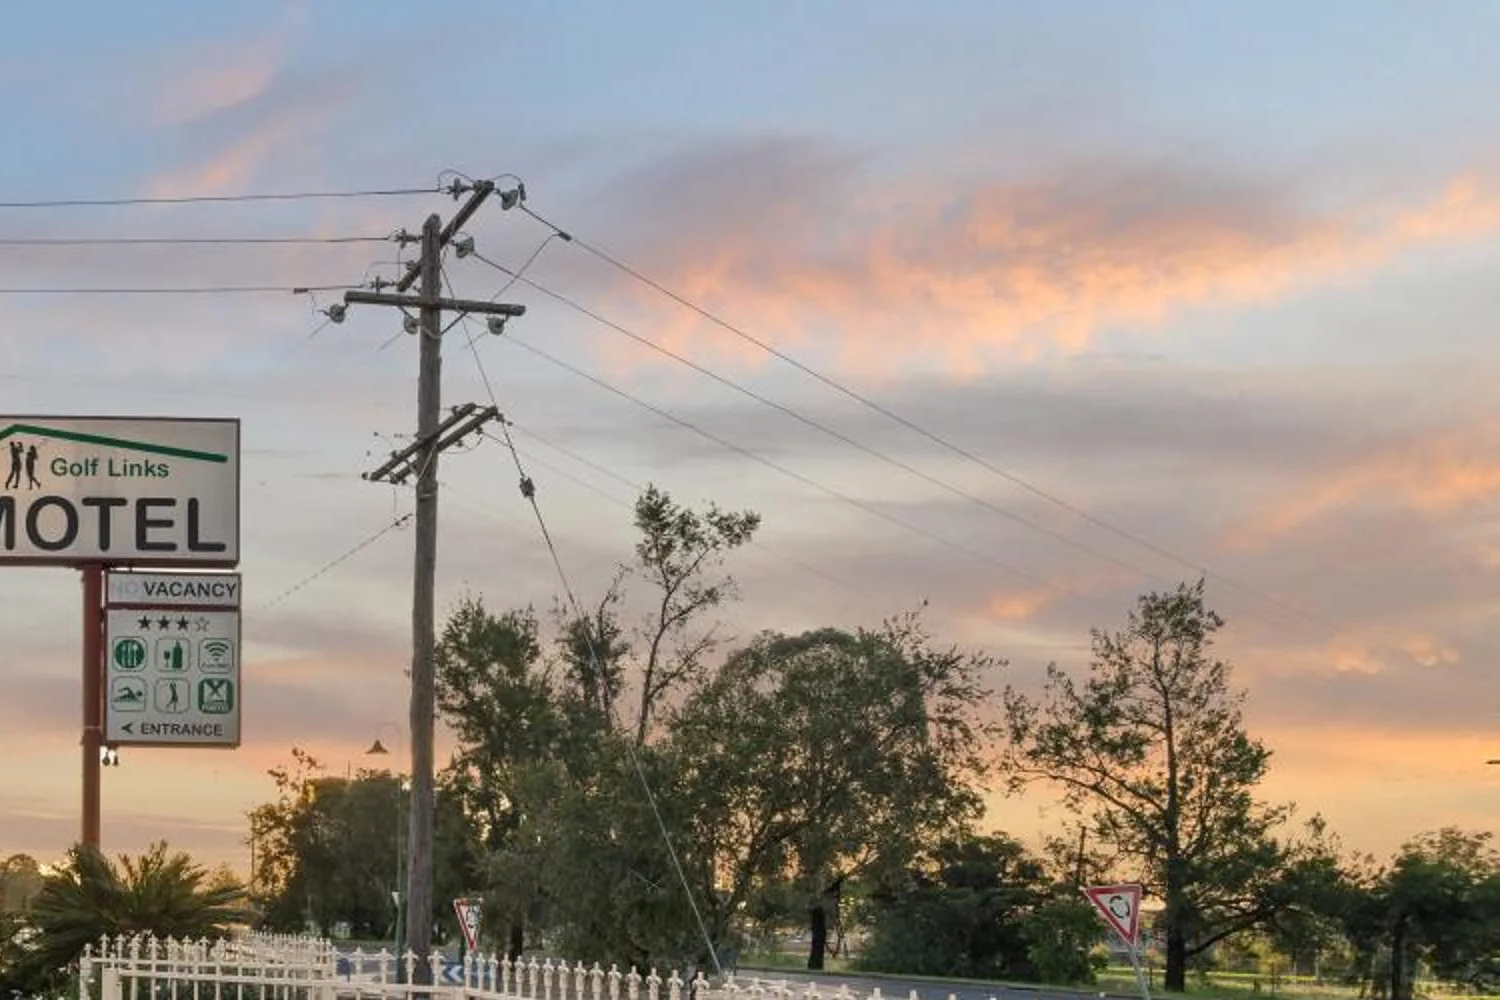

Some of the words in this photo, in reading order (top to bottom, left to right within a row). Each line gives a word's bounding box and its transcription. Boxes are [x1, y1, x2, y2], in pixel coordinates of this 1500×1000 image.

[50, 458, 100, 477] Golf
[108, 458, 170, 478] Links
[143, 581, 237, 598] VACANCY
[140, 723, 224, 736] ENTRANCE
